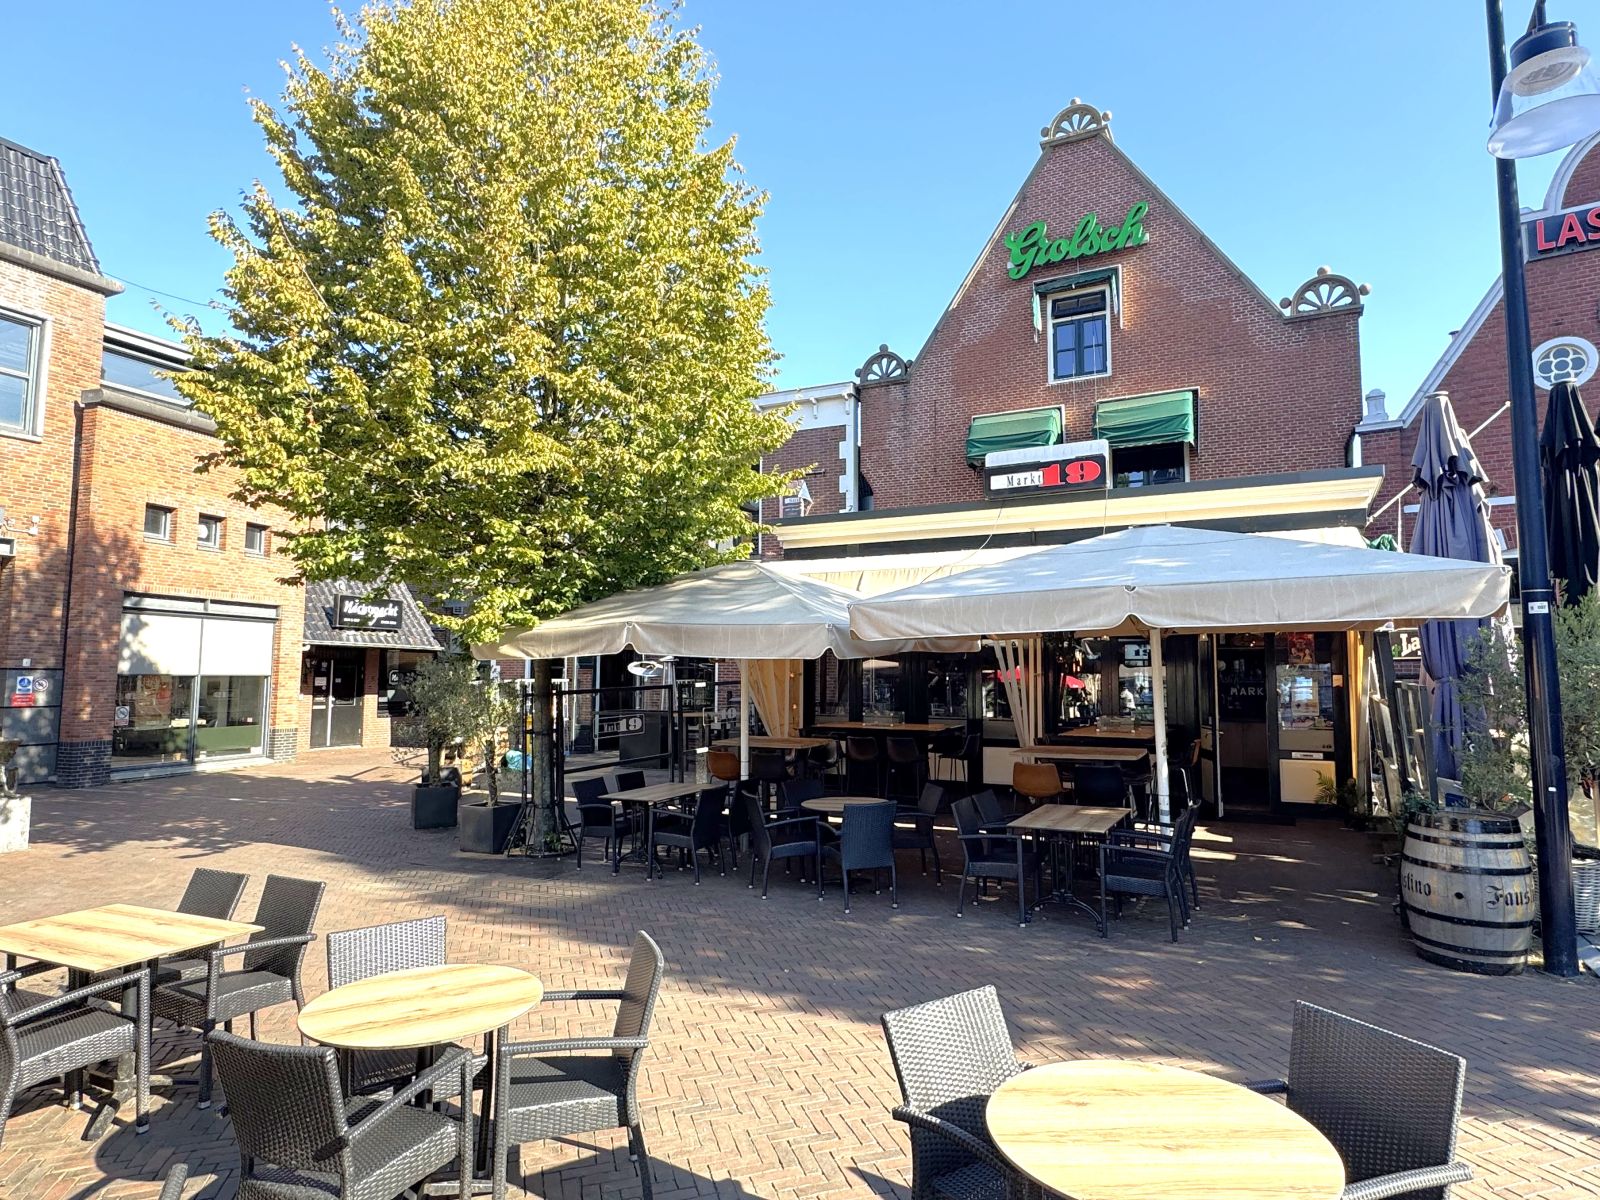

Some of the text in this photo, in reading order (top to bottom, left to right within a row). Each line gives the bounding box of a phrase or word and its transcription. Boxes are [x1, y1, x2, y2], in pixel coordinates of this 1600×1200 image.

[1004, 201, 1149, 280] Grolsch
[1006, 460, 1101, 487] Markt 19
[1400, 633, 1421, 657] La
[1402, 872, 1432, 896] stino
[1486, 885, 1534, 909] Faus
